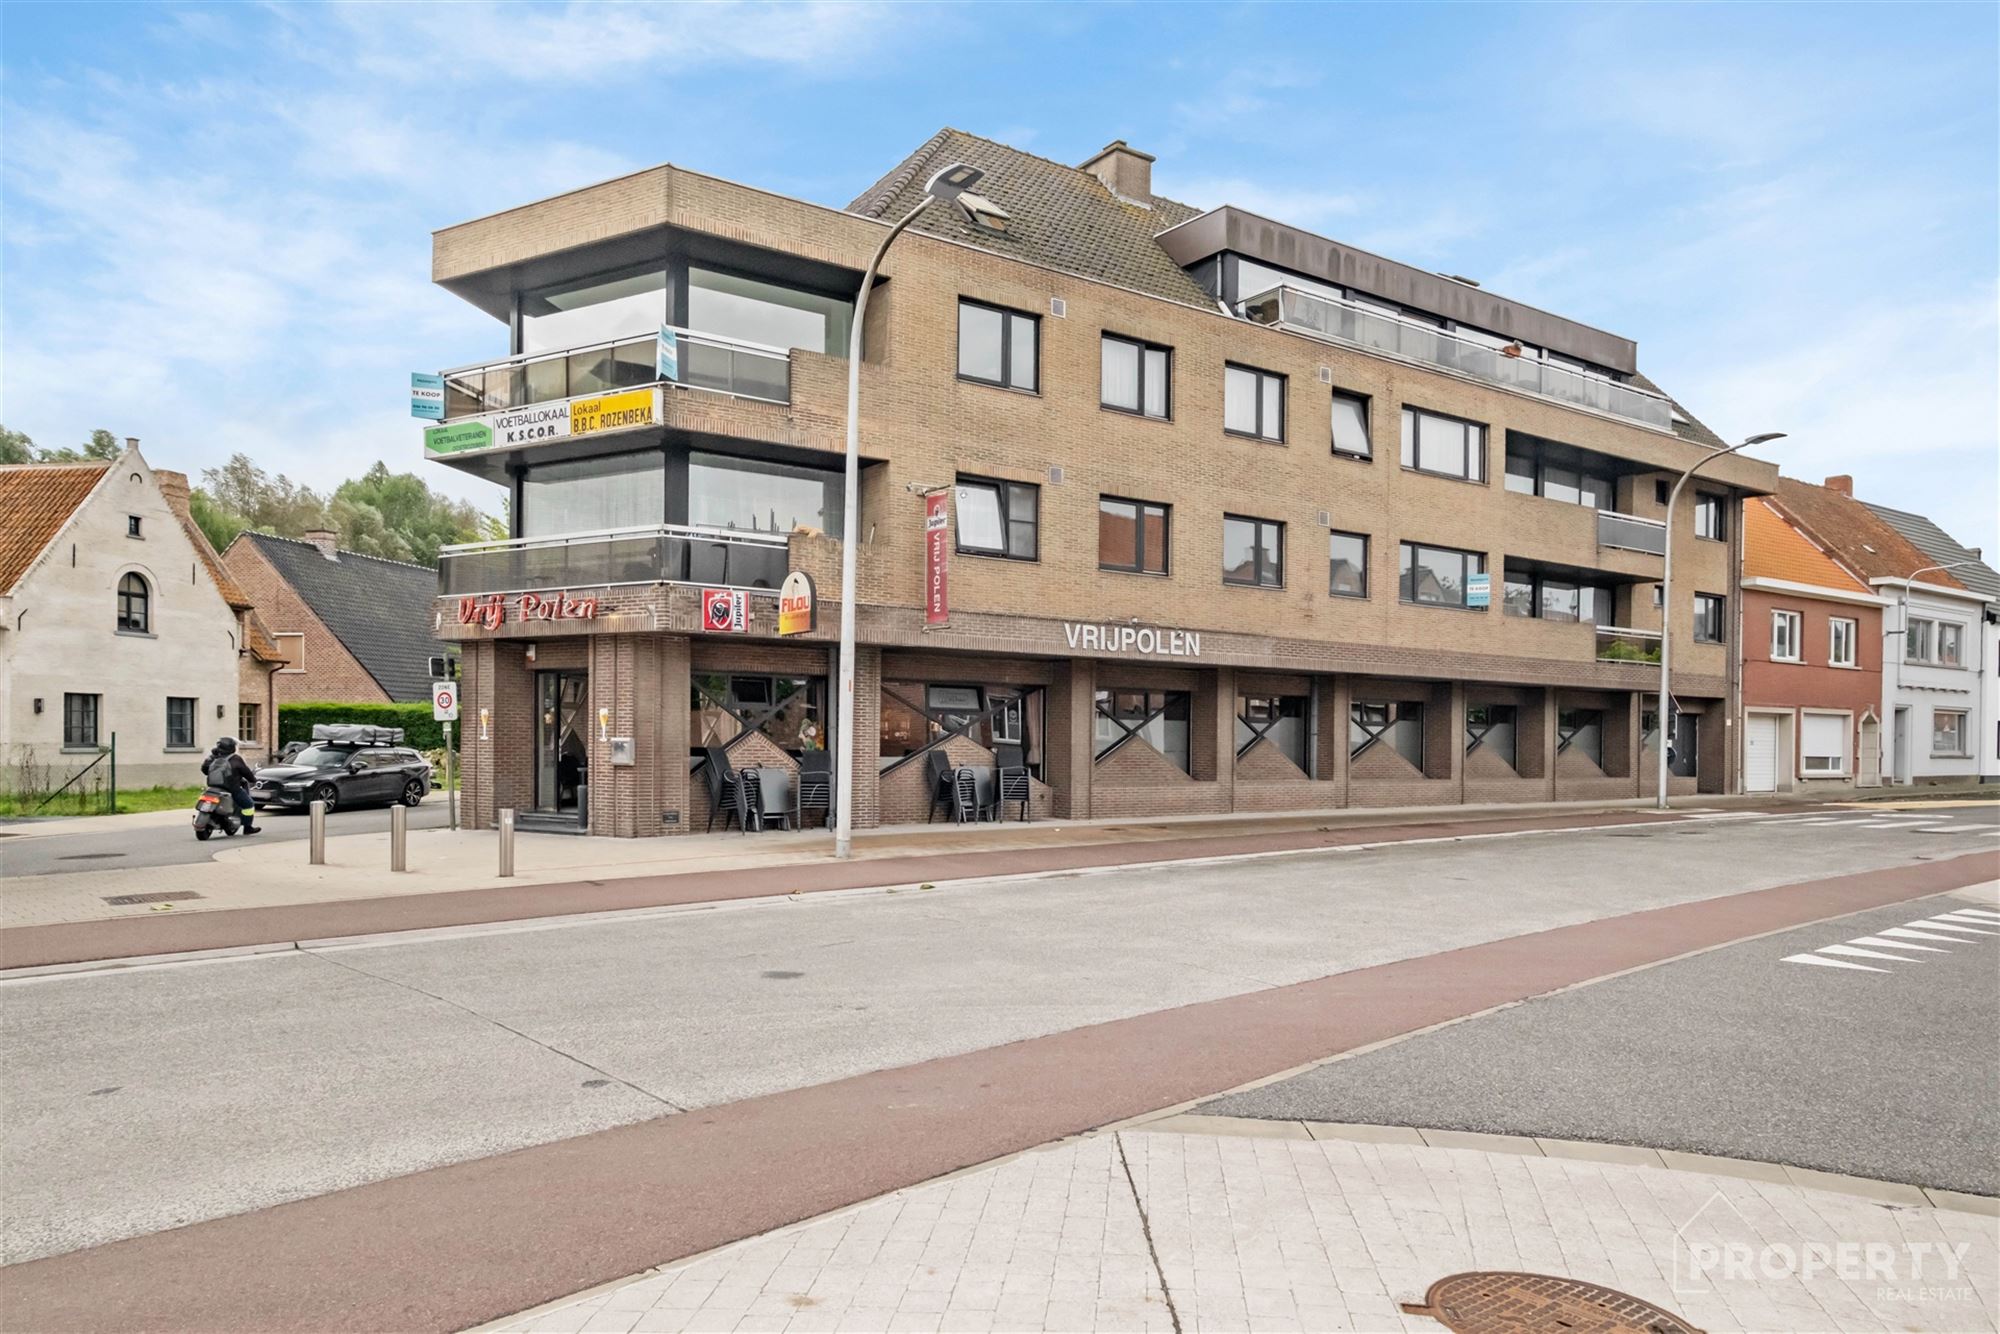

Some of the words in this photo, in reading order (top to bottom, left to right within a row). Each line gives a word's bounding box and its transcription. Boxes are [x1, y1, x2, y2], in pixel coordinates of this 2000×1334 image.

[496, 407, 569, 429] VOETBALLOKAAL
[573, 401, 601, 416] Lokaal
[573, 416, 598, 433] B.B.C.
[600, 406, 653, 429] ROZENBEKA
[933, 532, 941, 561] VRIJ
[933, 566, 941, 613] POLEN
[458, 594, 505, 631] Vrij
[515, 592, 598, 622] Polen
[734, 593, 744, 629] Jupiler
[782, 595, 811, 613] FILOU
[1064, 623, 1200, 657] VRIJPOLEN
[440, 696, 449, 705] 30
